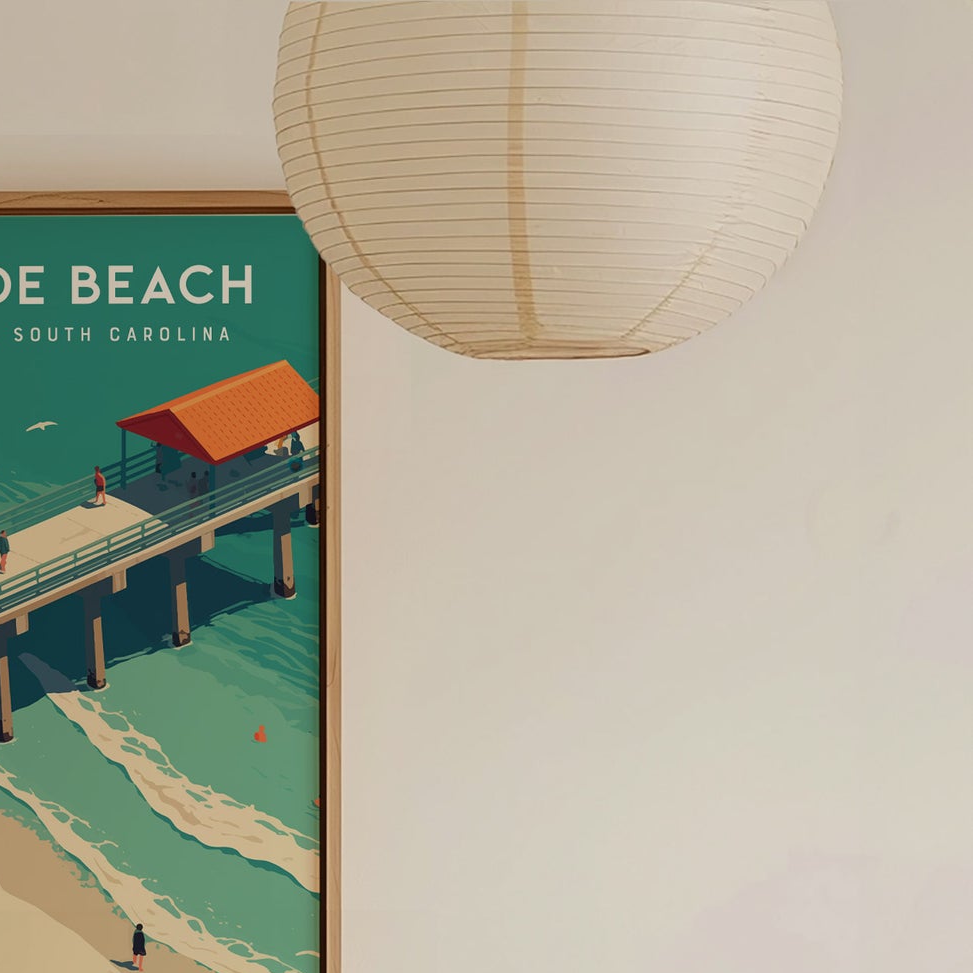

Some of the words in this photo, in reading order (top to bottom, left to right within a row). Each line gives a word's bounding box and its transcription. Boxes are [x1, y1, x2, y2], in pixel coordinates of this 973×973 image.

[70, 264, 253, 305] BEACH
[13, 326, 92, 343] SOUTH
[109, 326, 231, 343] CAROLINA
